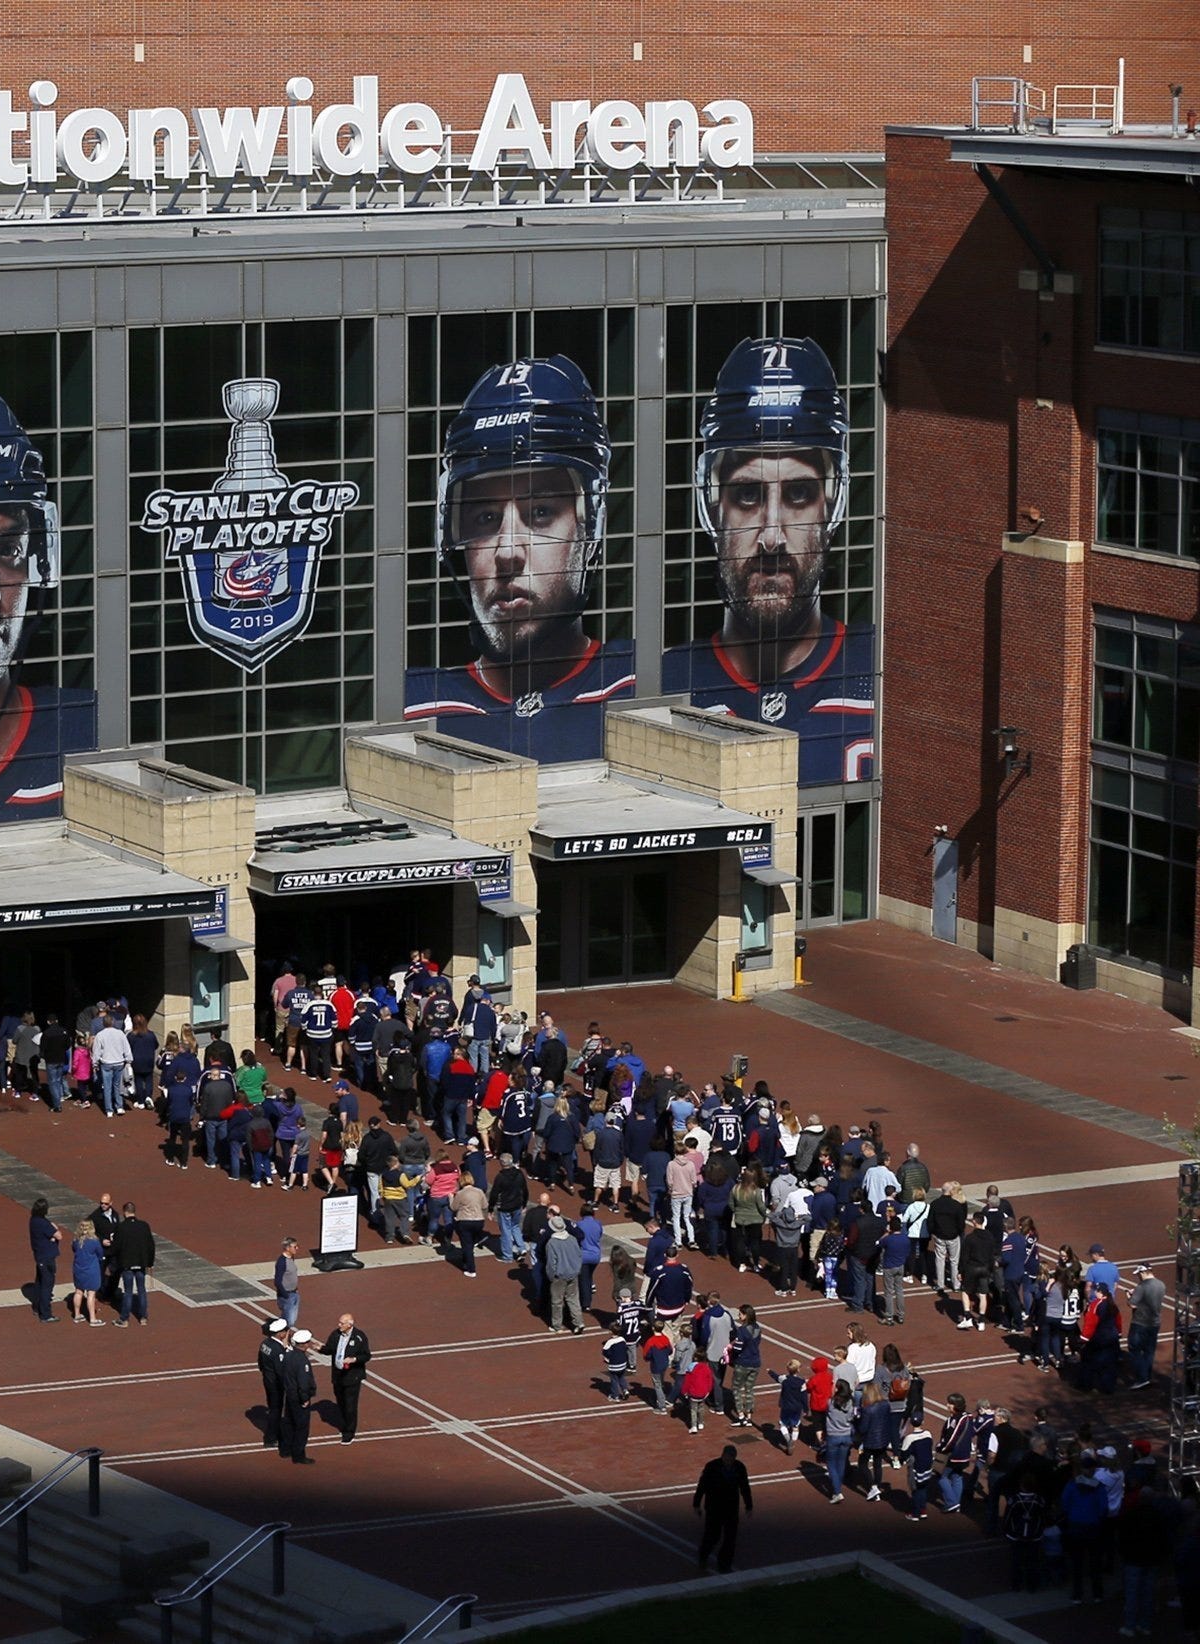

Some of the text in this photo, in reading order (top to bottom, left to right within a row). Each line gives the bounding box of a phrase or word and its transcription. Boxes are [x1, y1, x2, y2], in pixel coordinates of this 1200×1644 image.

[469, 73, 753, 171] Arena
[763, 346, 788, 368] 71
[496, 362, 533, 388] 13
[474, 411, 532, 431] BAUER
[147, 485, 356, 526] STANLEY CUP
[172, 517, 329, 551] PLAYOFFS
[230, 615, 274, 630] 2019
[563, 840, 605, 854] LET'S
[633, 833, 697, 849] JACKETS
[283, 873, 347, 888] STANLEY
[346, 870, 378, 883] CUP
[377, 864, 452, 880] PLAYOFFS
[14, 909, 44, 921] TIME.
[312, 1011, 326, 1026] 71
[516, 1100, 526, 1118] 3
[722, 1123, 735, 1141] 13
[1064, 1298, 1078, 1316] 13
[625, 1317, 639, 1335] 72
